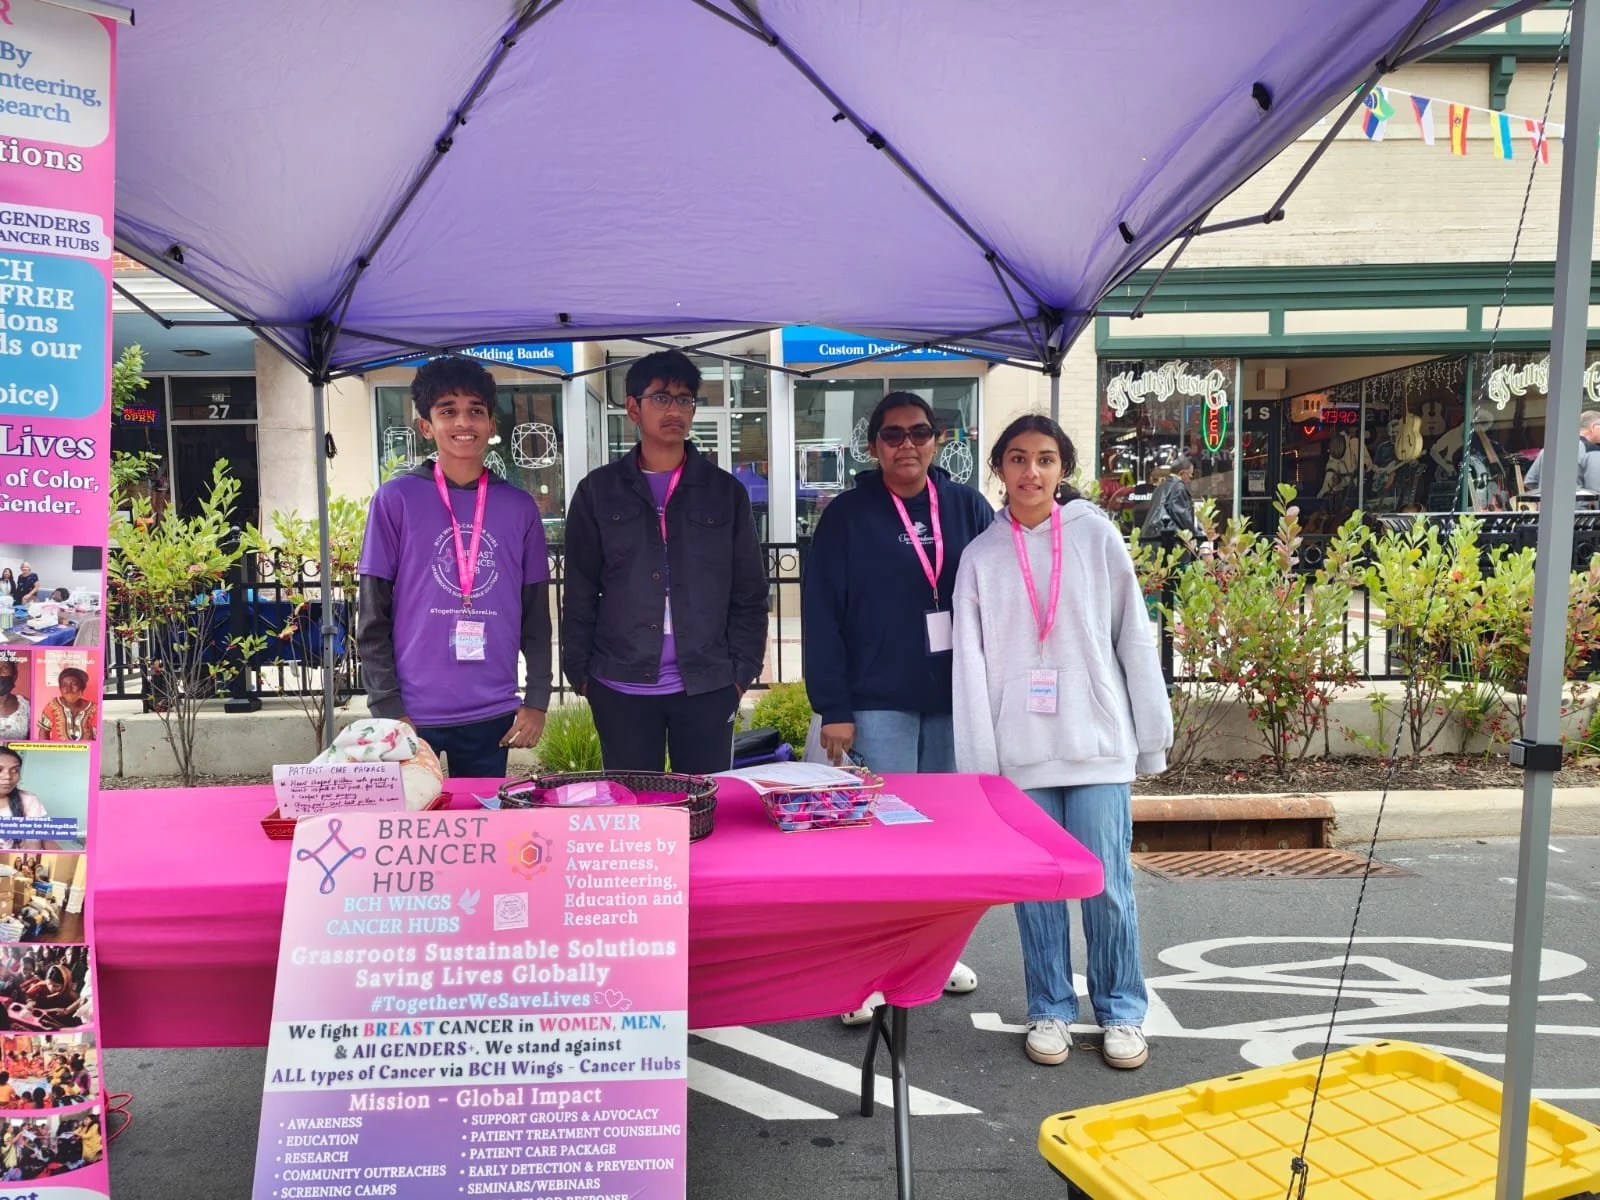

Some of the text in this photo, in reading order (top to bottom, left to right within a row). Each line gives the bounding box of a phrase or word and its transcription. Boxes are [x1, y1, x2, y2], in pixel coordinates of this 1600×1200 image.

[0, 40, 32, 68] By
[0, 138, 83, 172] tions
[0, 210, 90, 235] GENDERS
[55, 236, 99, 252] HUBS
[0, 284, 74, 310] FREE
[31, 341, 81, 360] our
[460, 347, 514, 361] Wedding
[517, 347, 554, 359] Bands
[819, 343, 864, 355] Custom
[868, 343, 906, 357] Desig
[123, 413, 155, 423] OPEN
[208, 404, 230, 419] 27
[0, 423, 96, 460] Lives
[5, 468, 99, 493] of Color,
[0, 494, 81, 515] Gender.
[289, 766, 323, 776] PATIENT
[378, 817, 489, 840] BREAST
[568, 814, 641, 832] SAVER
[375, 843, 497, 866] CANCER
[566, 837, 677, 855] Save Lives by
[565, 857, 659, 872] Awareness,
[373, 871, 435, 893] HUB
[565, 874, 677, 890] Volunteering,
[343, 894, 451, 913] BCH WINGS
[564, 891, 683, 908] Education and
[326, 916, 460, 936] CANCER HUBS
[563, 910, 638, 926] Research
[291, 938, 677, 965] Grassroots Sustainable Solutions
[355, 962, 610, 991] Saving Lives Globally
[370, 991, 591, 1014] #TogetherWeSaveLives
[288, 1014, 666, 1042] We fight BREAST CANCER in WOMEN, MEN,
[334, 1045, 348, 1059] &
[352, 1043, 376, 1059] All
[485, 1040, 513, 1055] We
[517, 1039, 560, 1054] stand
[564, 1038, 622, 1056] against
[272, 1068, 306, 1083] ALL
[311, 1067, 354, 1085] types
[358, 1065, 375, 1080] of
[379, 1064, 436, 1079] Cancer
[439, 1063, 463, 1078] via
[469, 1061, 506, 1077] BCH
[511, 1060, 563, 1079] Wings
[579, 1059, 636, 1073] Cancer
[640, 1056, 681, 1071] Hubs
[348, 1092, 431, 1111] Mission
[456, 1088, 524, 1107] Global
[531, 1087, 602, 1109] Impact
[287, 1116, 363, 1130] AWARENESS
[471, 1108, 660, 1125] SUPPORT GROUPS & ADVOCACY
[286, 1134, 359, 1147] EDUCATION
[470, 1124, 681, 1142] PATIENT TREATMENT COUNSELING
[284, 1151, 349, 1164] RESEARCH
[470, 1144, 616, 1160] PATIENT CARE PACKAGE
[282, 1165, 447, 1181] COMMUNITY OUTREACHES
[469, 1158, 675, 1177] EARLY DETECTION & PREVENTION
[281, 1184, 397, 1199] SCREENING CAMPS
[467, 1178, 601, 1195] SEMINARS/WEBINARS
